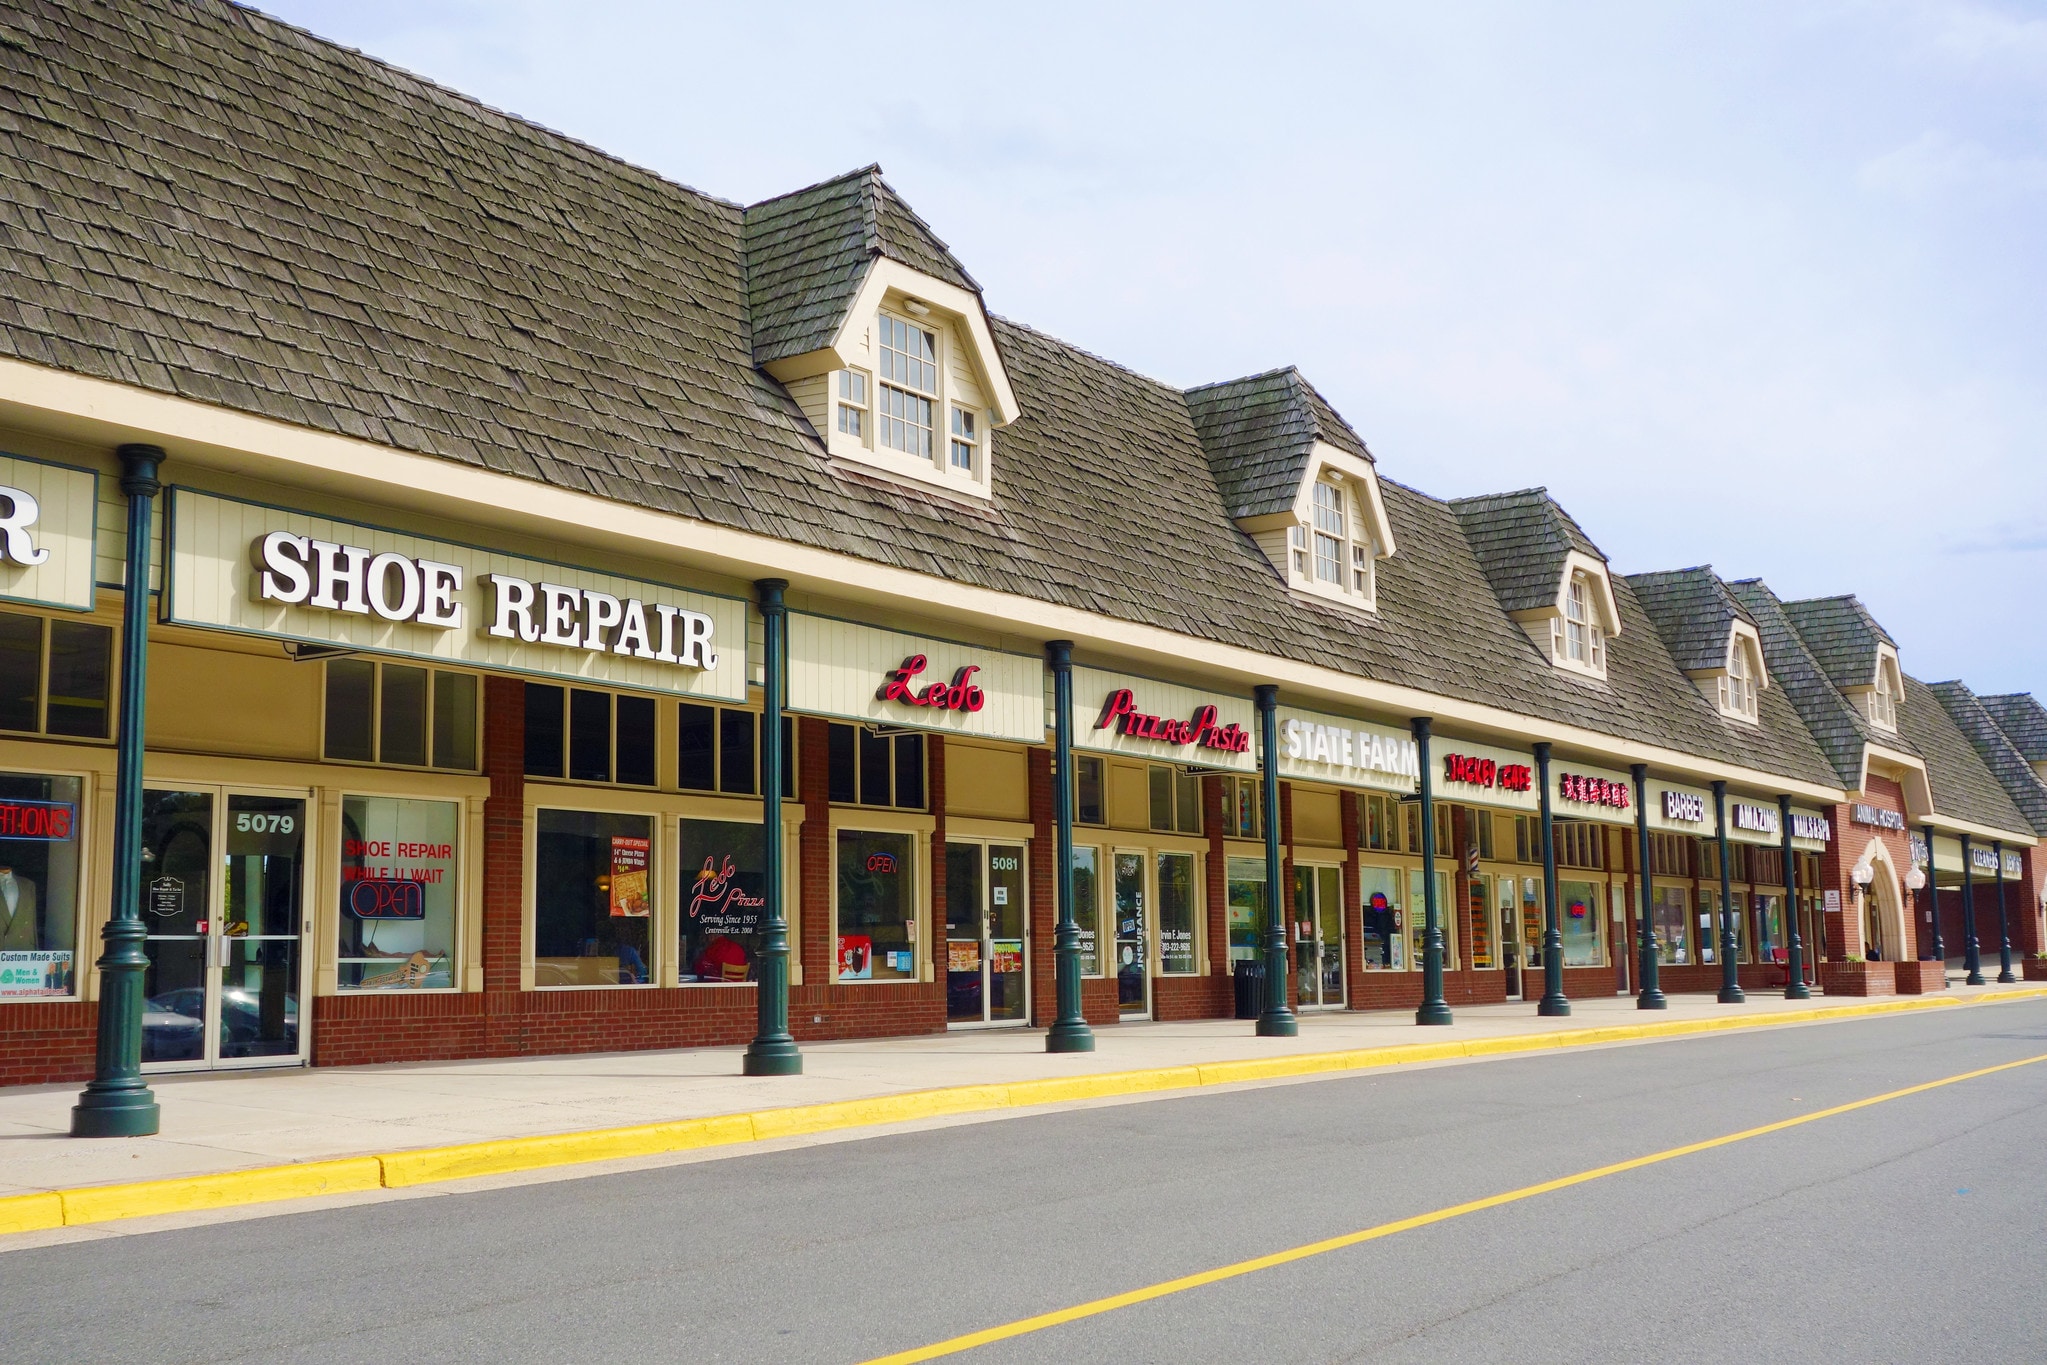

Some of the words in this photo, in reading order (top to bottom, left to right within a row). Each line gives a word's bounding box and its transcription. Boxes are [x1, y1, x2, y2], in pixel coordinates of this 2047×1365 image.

[260, 530, 464, 630] SHOE
[488, 572, 720, 672] REPAIR
[885, 653, 985, 713] Ledo
[1287, 718, 1353, 768] STATE
[1358, 731, 1420, 778] FARM
[1501, 763, 1532, 792] CAFE
[1667, 791, 1705, 823] BARBER
[1856, 804, 1879, 825] ANIMAL
[236, 813, 295, 835] 5079
[1738, 804, 1778, 833] AMAZING
[345, 839, 390, 857] SHOE
[398, 842, 452, 859] REPAIR
[1973, 848, 1999, 870] CLEANERS
[342, 865, 388, 882] WHILE
[394, 867, 405, 883] U
[411, 868, 444, 884] WAIT
[867, 856, 898, 874] OPEN
[991, 857, 1019, 871] 5081
[689, 853, 736, 918] Ledo
[699, 914, 724, 927] Serving
[724, 914, 741, 924] Since
[742, 915, 758, 924] 1955
[704, 926, 730, 935] Centreville
[1135, 891, 1143, 968] INSURANCE
[1160, 929, 1172, 940] Irvin
[1176, 929, 1192, 940] Jones
[0, 952, 28, 962] Custom
[30, 952, 50, 962] Made
[52, 953, 71, 962] Suits
[15, 968, 31, 976] Men
[15, 977, 40, 985] Women
